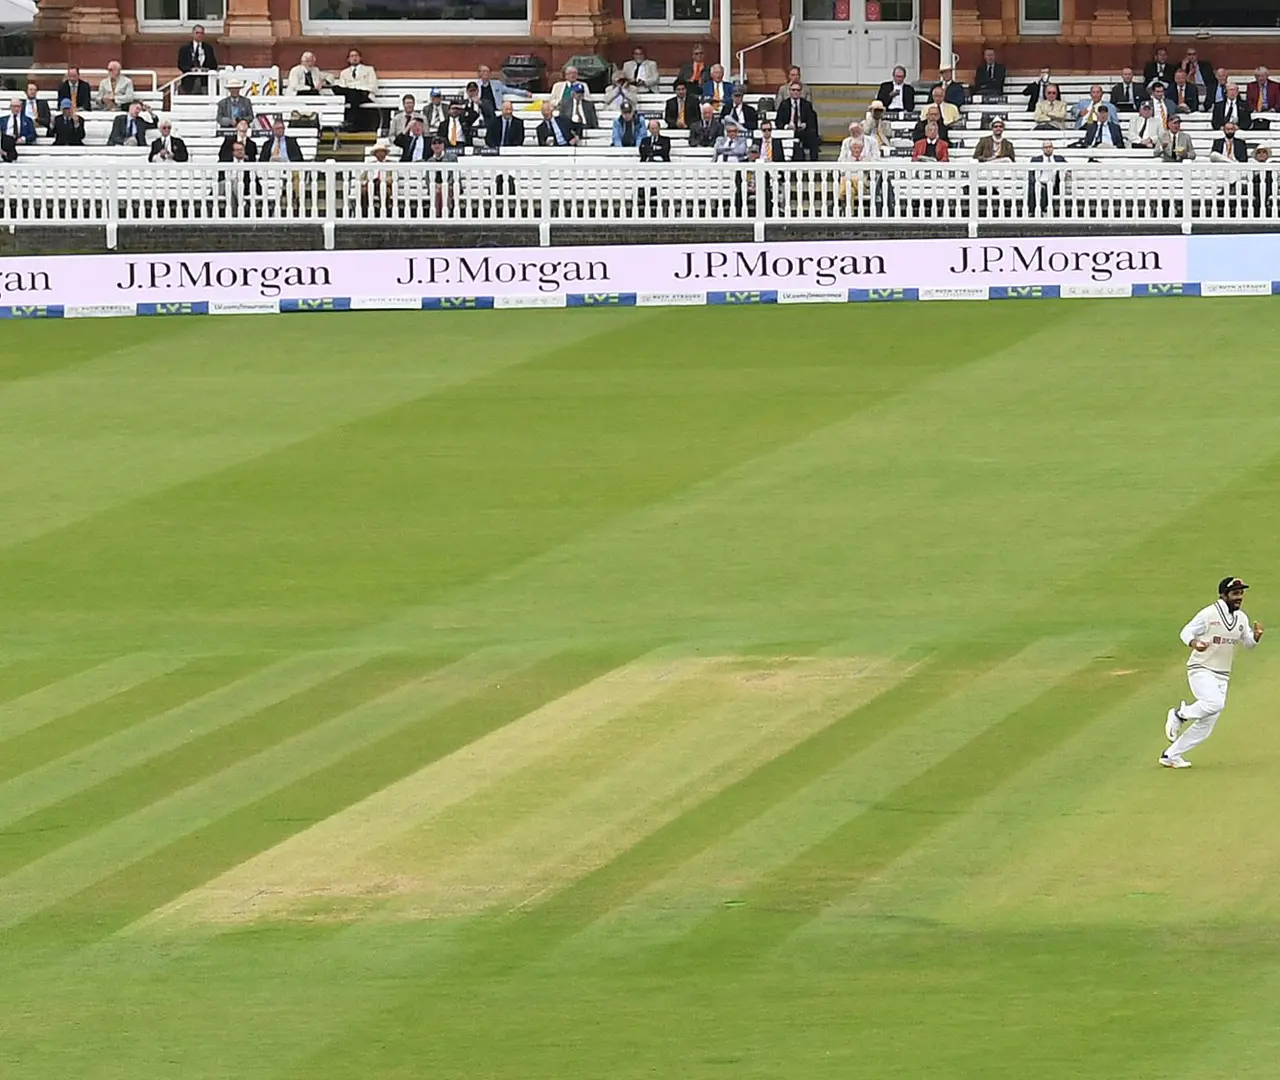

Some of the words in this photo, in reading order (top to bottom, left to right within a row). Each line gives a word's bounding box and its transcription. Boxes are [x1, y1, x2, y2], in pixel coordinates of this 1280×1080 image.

[116, 261, 332, 298] J.P.Morgan
[396, 256, 611, 292] J.P.Morgan
[673, 251, 888, 287] J.P.Morgan
[950, 245, 1163, 282] J.P.Morgan
[0, 271, 52, 299] an
